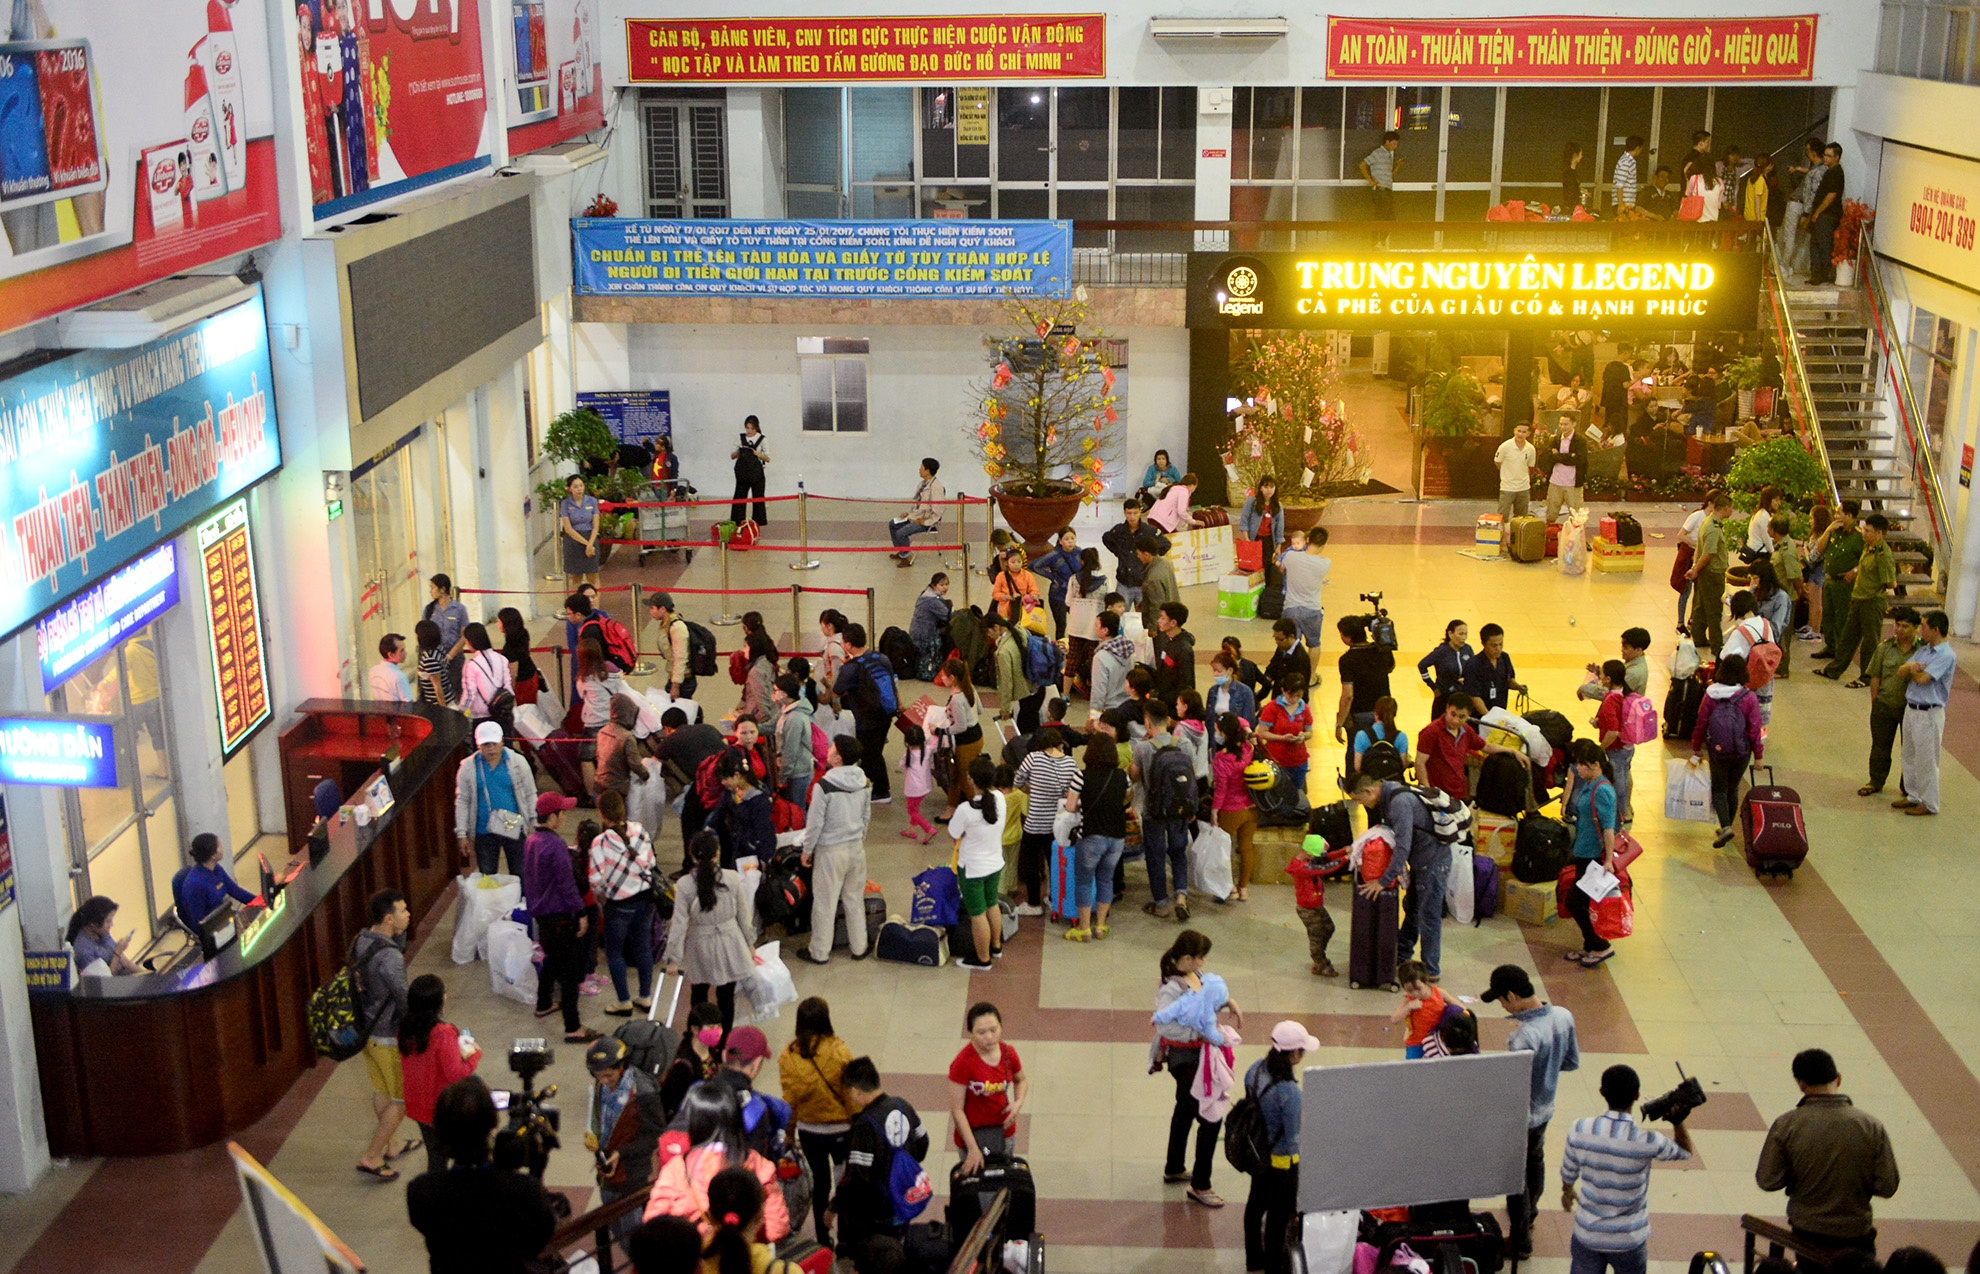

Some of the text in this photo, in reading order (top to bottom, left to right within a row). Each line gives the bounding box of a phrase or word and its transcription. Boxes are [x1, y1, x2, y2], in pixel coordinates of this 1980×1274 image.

[710, 25, 749, 47] ĐẢNG
[753, 26, 790, 49] VIÊN,
[796, 29, 822, 46] CNV
[828, 25, 857, 46] TÍCH
[862, 26, 889, 49] CỰC
[894, 25, 928, 48] THỰC
[933, 24, 966, 48] HIỆN
[971, 24, 1001, 47] CUỘC
[1012, 24, 1041, 47] VẬN
[1046, 23, 1084, 46] ĐỘNG
[1339, 22, 1799, 74] AN TOÀN THUẬN TIỆN THÂN THIỆN ĐÚNG GIỜ HIỆU QUẢ
[60, 49, 85, 72] 2016
[663, 48, 1061, 77] HỌC TẬP VÀ LÀM THEO TẤM GƯƠNG ĐẠO ĐỨC HỒ CHÍ MINH
[643, 234, 661, 244] LÊN
[684, 235, 698, 245] VÀ
[654, 224, 680, 234] NGÀY
[684, 226, 729, 235] 17/01/2017
[774, 226, 800, 236] NGÀY
[988, 227, 1014, 236] SOÁT
[1910, 202, 1976, 251] 0904 204 389
[591, 246, 1050, 267] CHUẨN BỊ THẺ LÊN TÀU HỎA VÀ GIẤY TỜ TÙY THÂN HỢP LỆ
[608, 264, 1034, 283] NGƯỜI ĐI TIỄN GIỚI HẠN TẠI TRƯỚC CỔNG KIỂM SOÁT
[1296, 254, 1715, 291] TRUNG NGUYÊN LEGEND
[1219, 300, 1264, 316] Legend
[1297, 291, 1708, 320] CÀ PHÊ CỦA GIÀU CÓ & HẠNH PHÚC
[16, 389, 42, 456] GÒN
[13, 484, 66, 594] THUẬN
[59, 470, 96, 576] TIỆN
[96, 450, 134, 541] THÂN
[128, 433, 168, 532] THIỆN
[167, 416, 200, 502] ĐÚNG
[198, 400, 219, 485] GIỜ
[219, 392, 244, 472] HIỆU
[242, 372, 266, 450] QUẢ
[63, 724, 103, 758] DẪN
